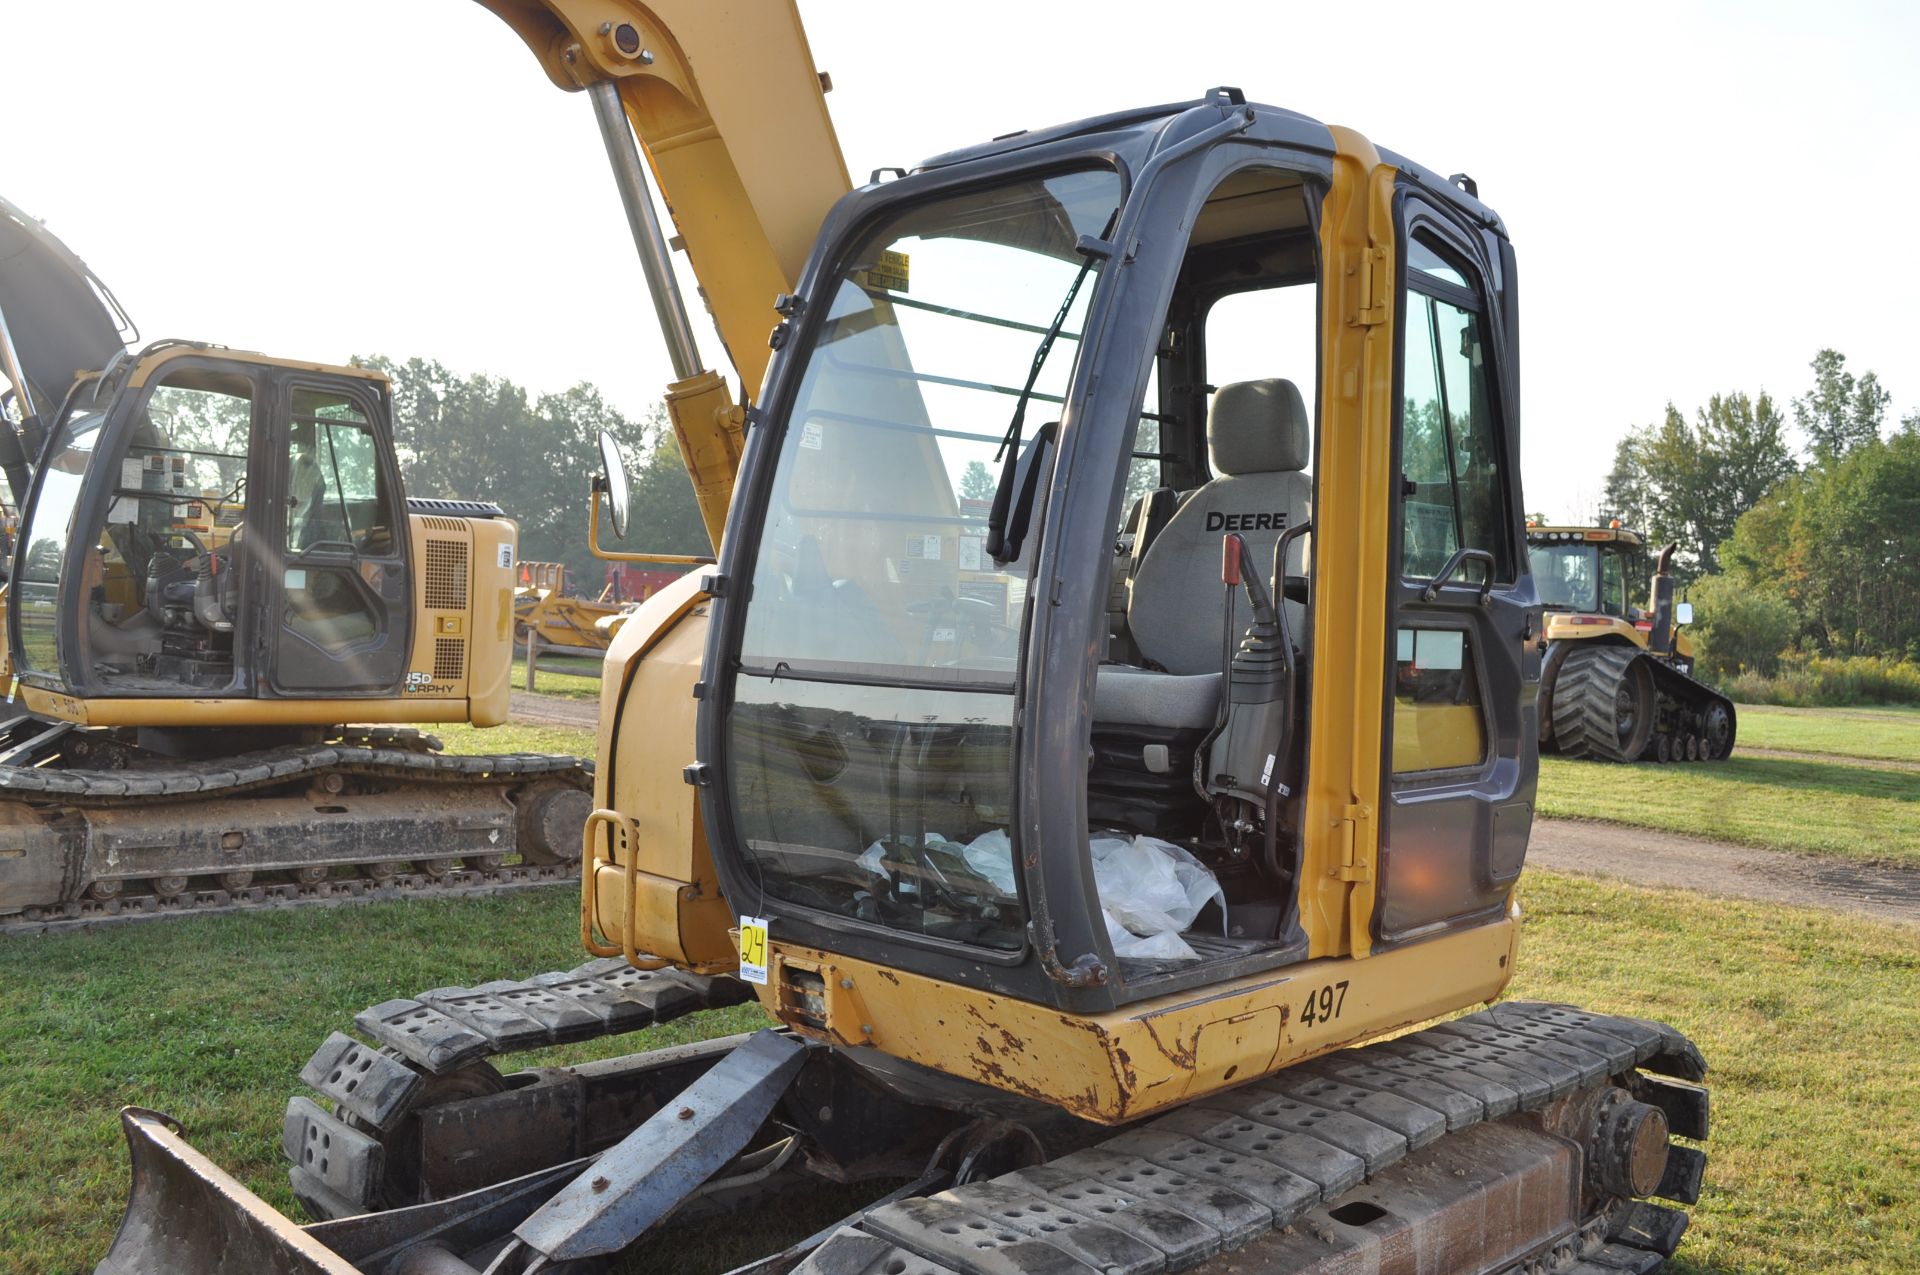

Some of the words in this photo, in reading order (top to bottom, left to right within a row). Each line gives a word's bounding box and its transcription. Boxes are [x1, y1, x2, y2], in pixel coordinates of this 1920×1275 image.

[1206, 511, 1288, 532] DEERE
[741, 926, 764, 968] 24
[1300, 980, 1350, 1028] 497
